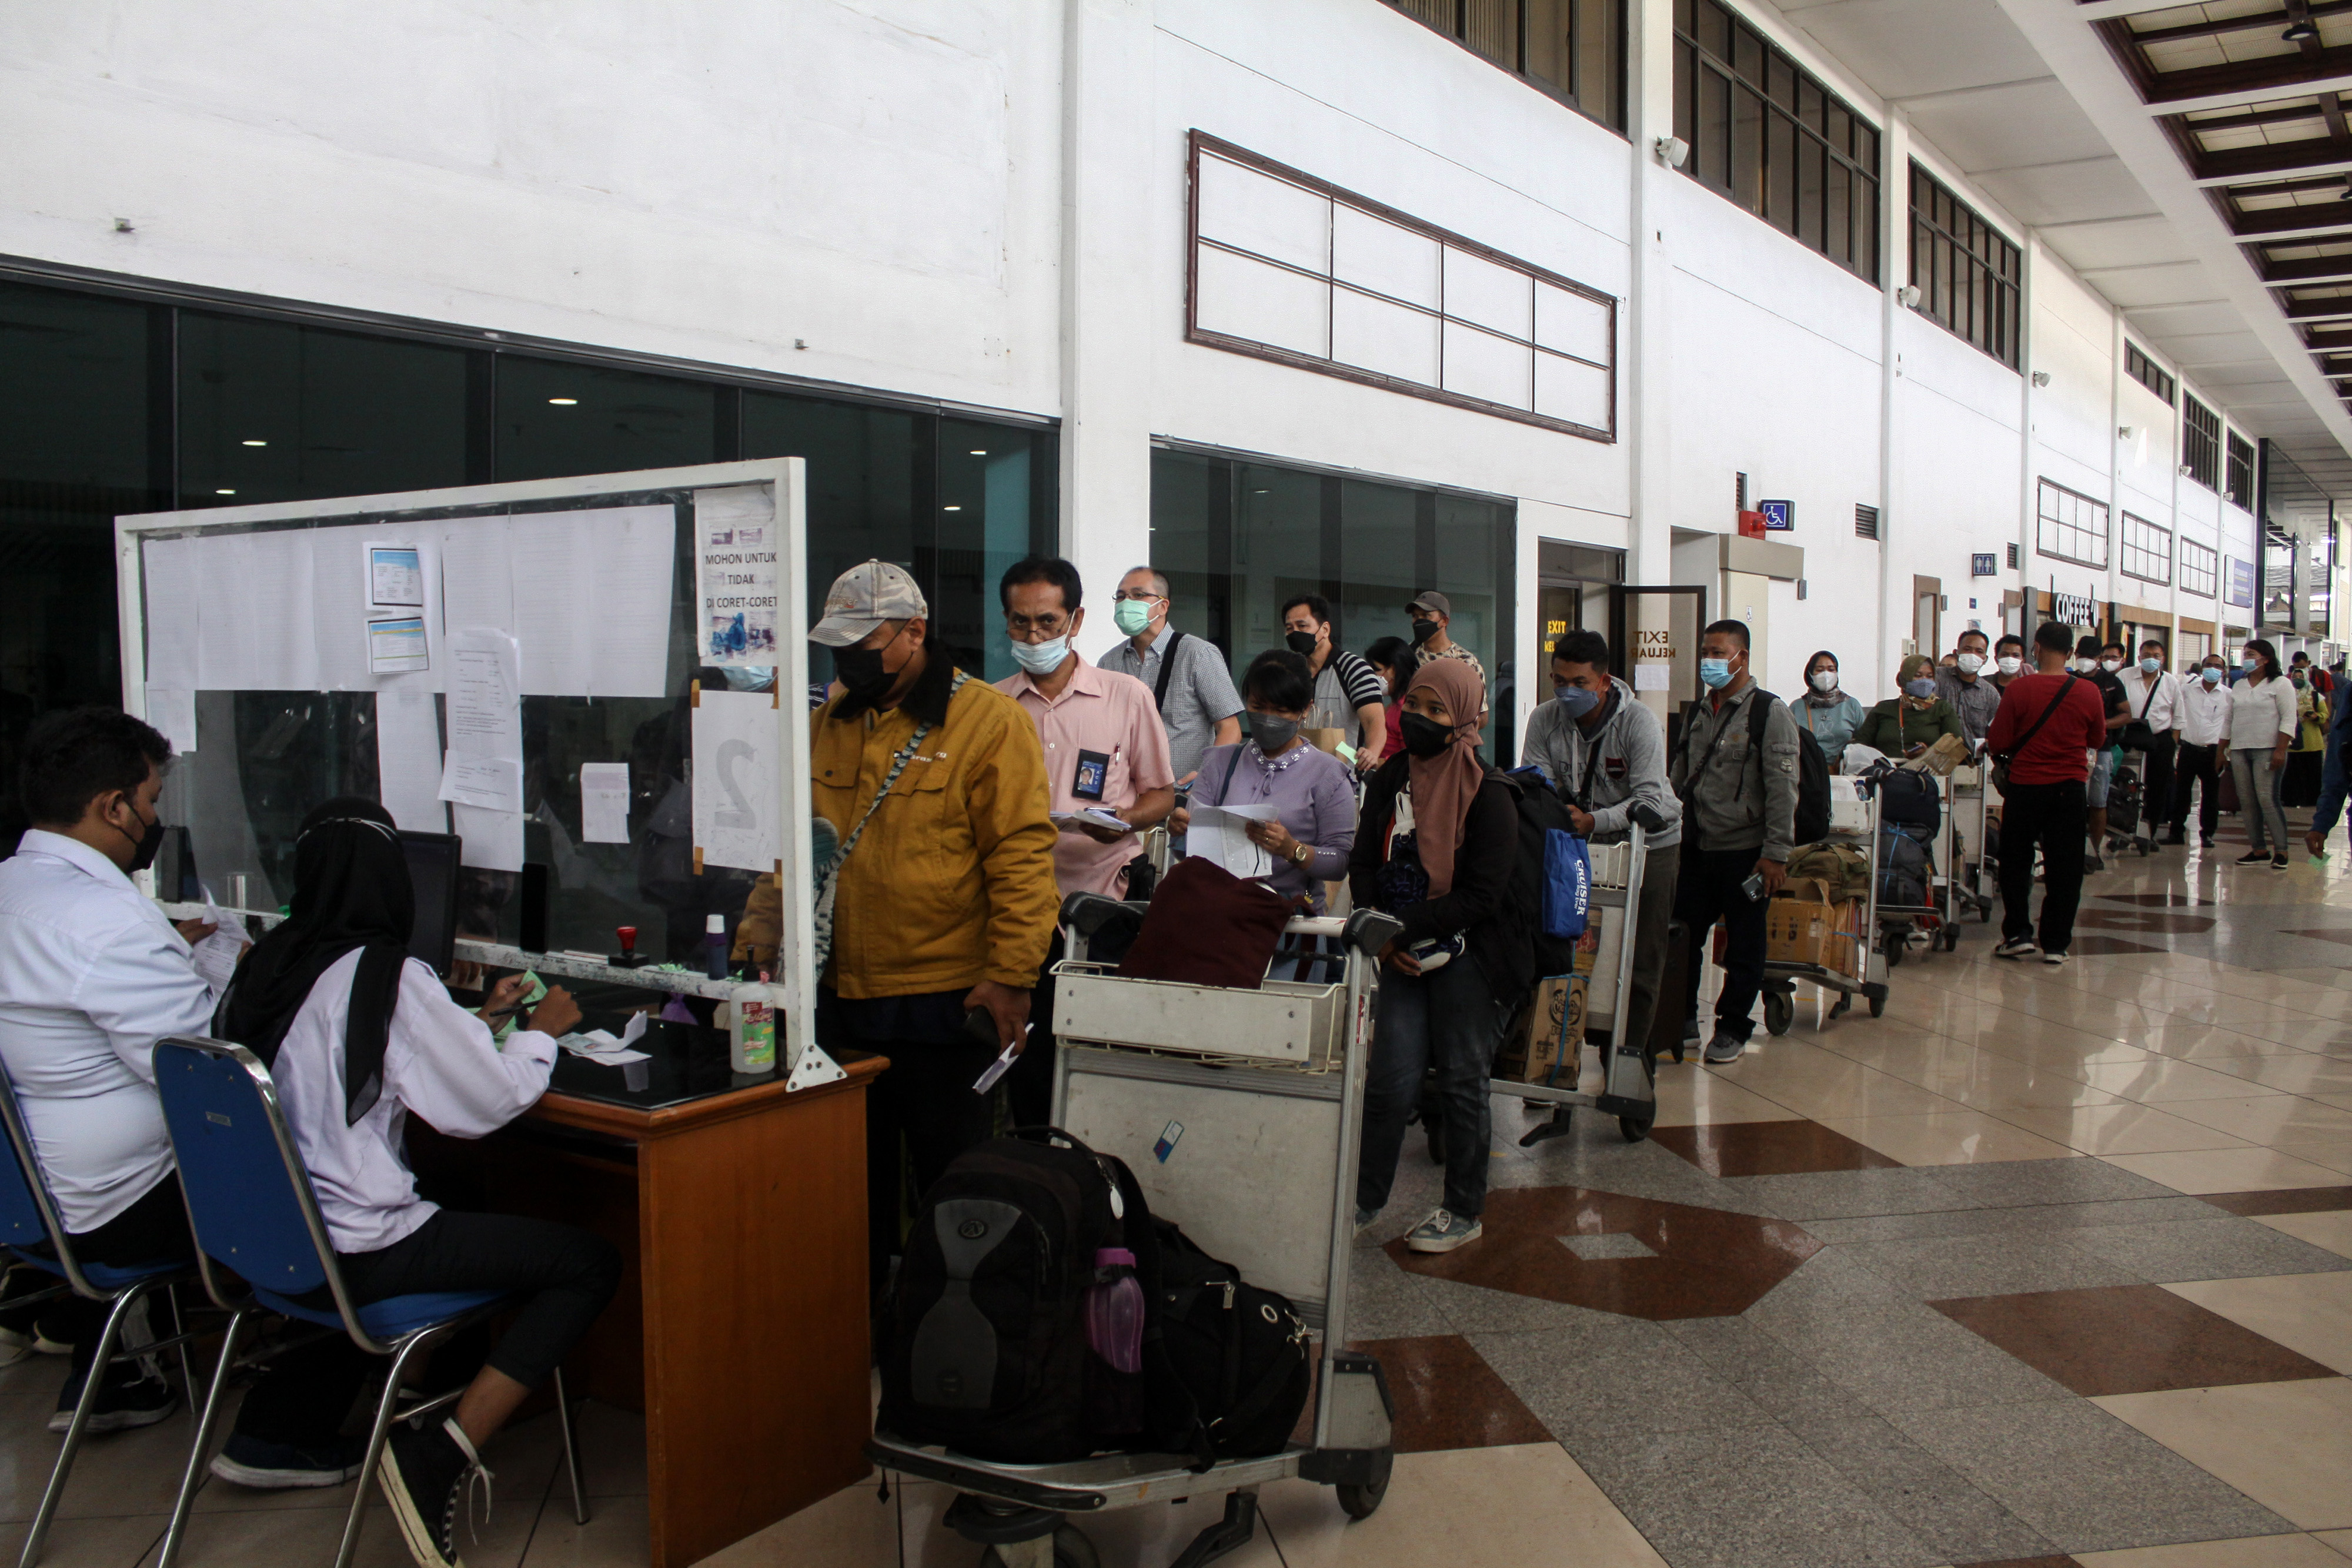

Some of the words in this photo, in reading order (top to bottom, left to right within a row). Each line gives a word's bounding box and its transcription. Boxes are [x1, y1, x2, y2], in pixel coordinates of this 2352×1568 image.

[706, 554, 741, 565] MOHON
[745, 552, 776, 563] UNTUK
[727, 574, 754, 585] TIDAK
[706, 598, 714, 608] DI
[717, 597, 777, 608] CORET-CORET
[1548, 620, 1566, 634] EXIT
[1576, 860, 1587, 915] CRUISER
